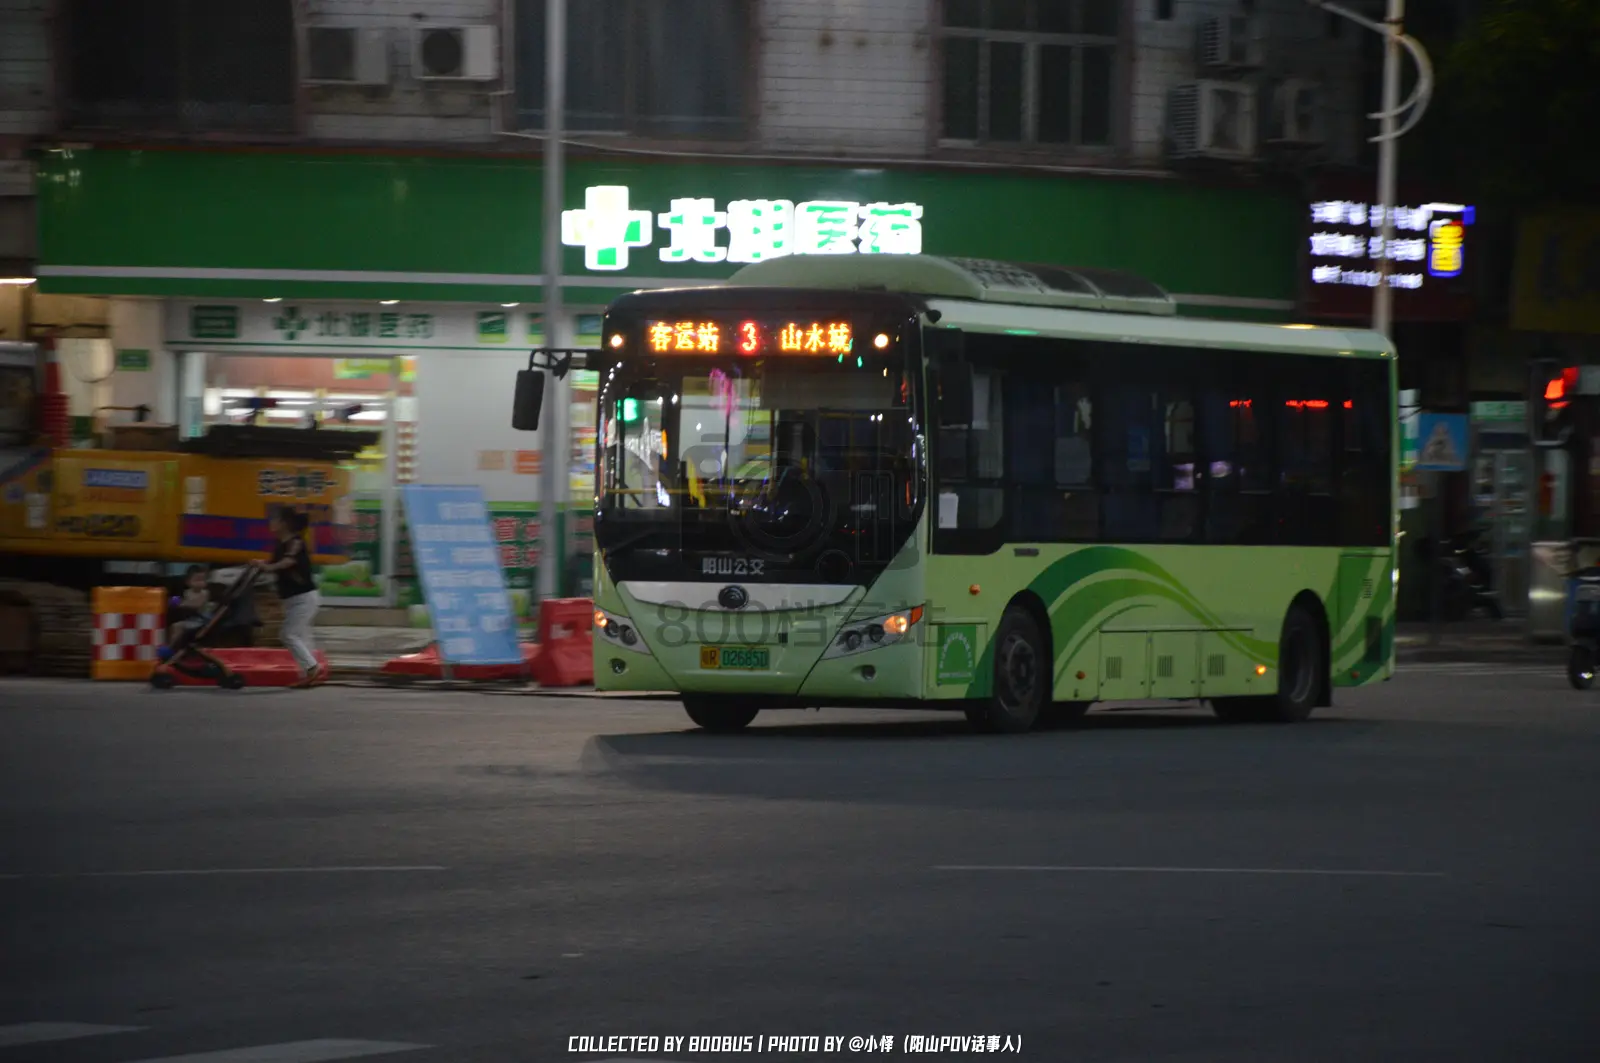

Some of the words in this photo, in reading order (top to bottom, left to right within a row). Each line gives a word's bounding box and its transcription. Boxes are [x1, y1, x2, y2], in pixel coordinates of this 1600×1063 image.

[650, 321, 721, 352] 客运站
[741, 321, 757, 352] 3
[780, 321, 851, 352] 山水城
[702, 556, 765, 575] 阳山公交
